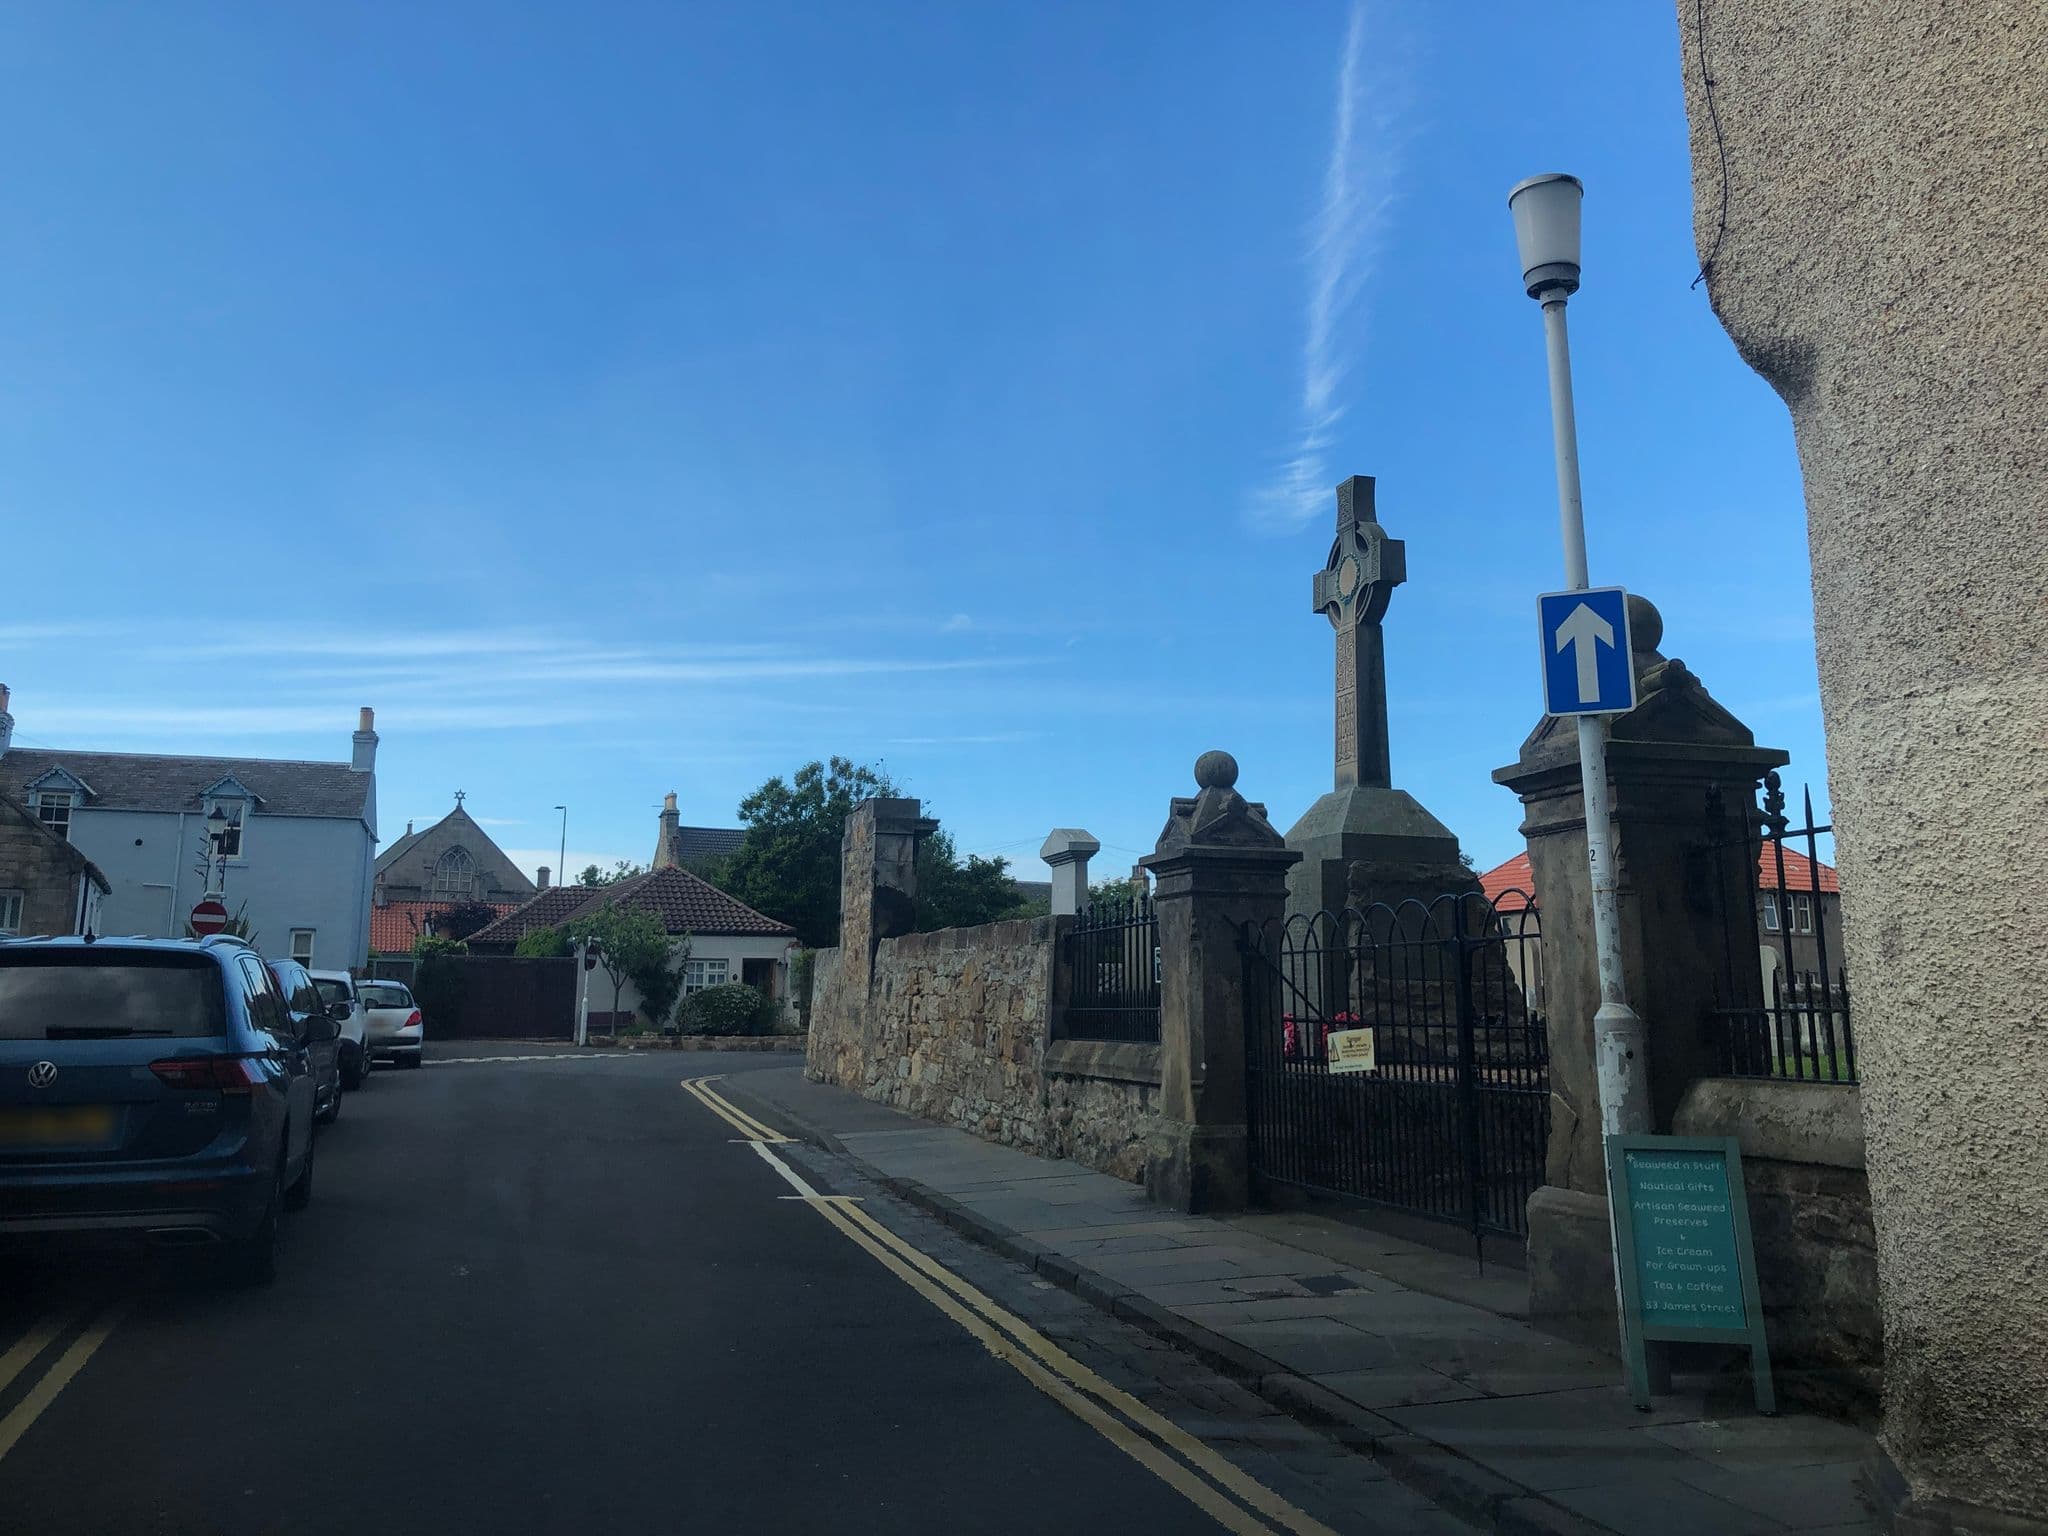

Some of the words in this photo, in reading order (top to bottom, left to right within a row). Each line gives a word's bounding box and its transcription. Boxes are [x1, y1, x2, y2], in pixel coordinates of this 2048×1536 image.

[1633, 1160, 1680, 1170] Seaweed
[1693, 1161, 1721, 1171] Stuff
[1639, 1181, 1685, 1191] Nautical
[1687, 1182, 1715, 1192] Gifts
[1634, 1201, 1675, 1211] Artisan
[1678, 1202, 1726, 1213] Seaweed
[1654, 1216, 1709, 1227] Preserves
[1657, 1246, 1674, 1256] Ice
[1676, 1247, 1713, 1257] Cream
[1646, 1260, 1664, 1270] For
[1654, 1280, 1674, 1290] Tea
[1686, 1282, 1725, 1293] Coffee
[1663, 1301, 1697, 1311] James
[1700, 1303, 1736, 1313] Street
